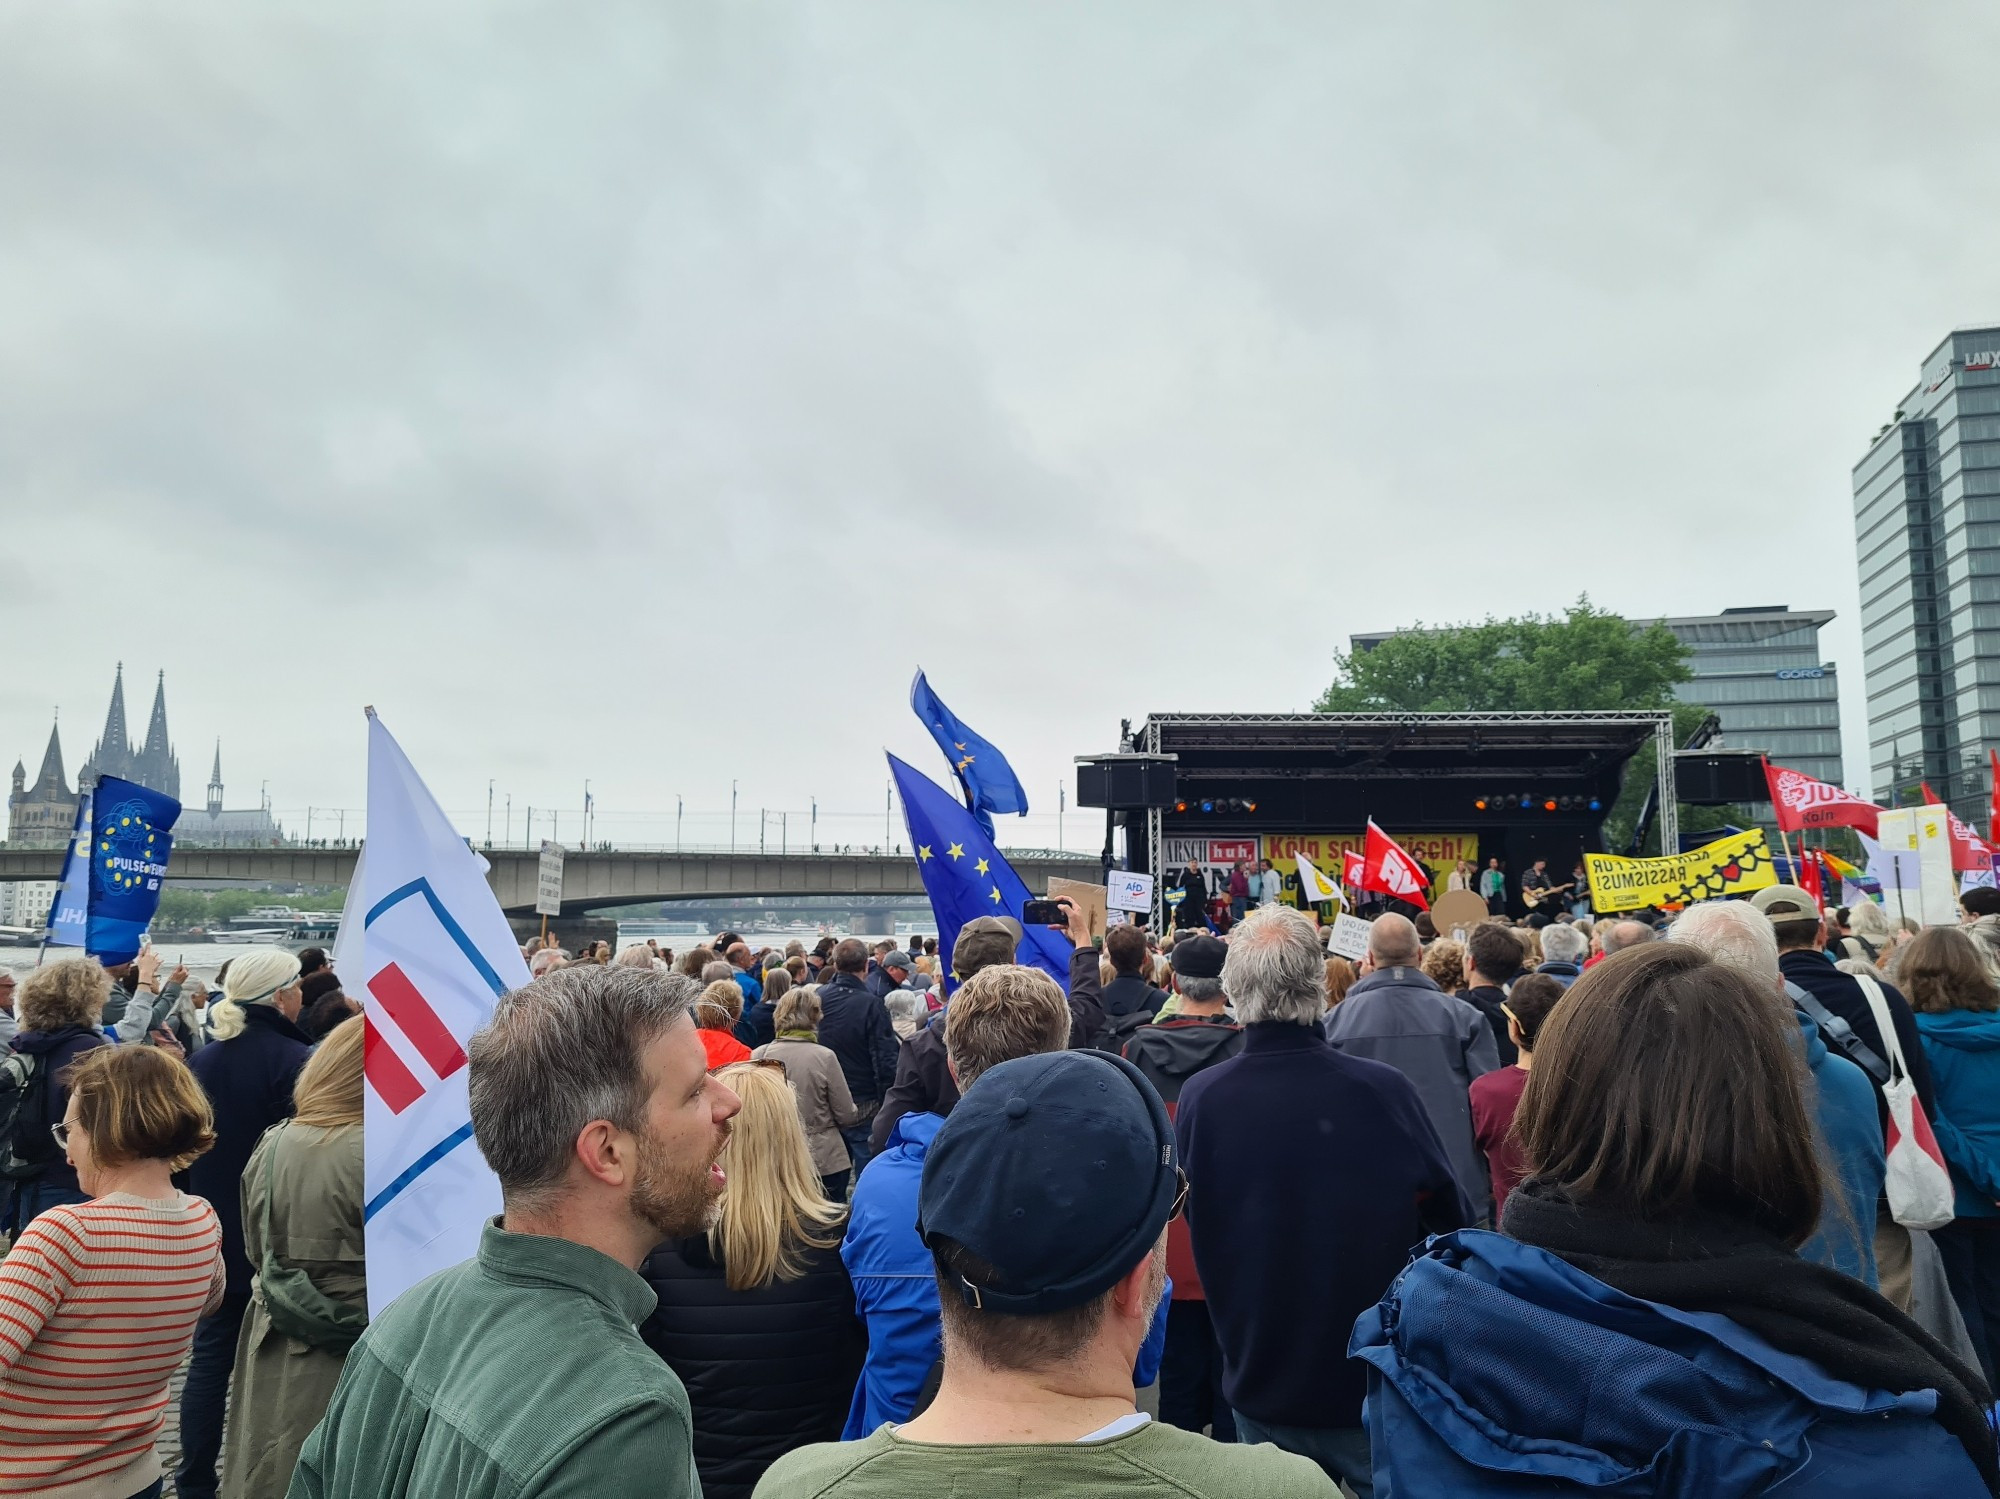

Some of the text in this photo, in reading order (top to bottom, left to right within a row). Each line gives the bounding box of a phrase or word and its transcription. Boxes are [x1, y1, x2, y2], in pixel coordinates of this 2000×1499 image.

[1803, 810, 1834, 824] Köln
[1166, 840, 1208, 862] ARSCH
[1270, 836, 1463, 860] Köln solirisch!
[114, 857, 146, 873] PULSE
[1125, 881, 1143, 892] AfD
